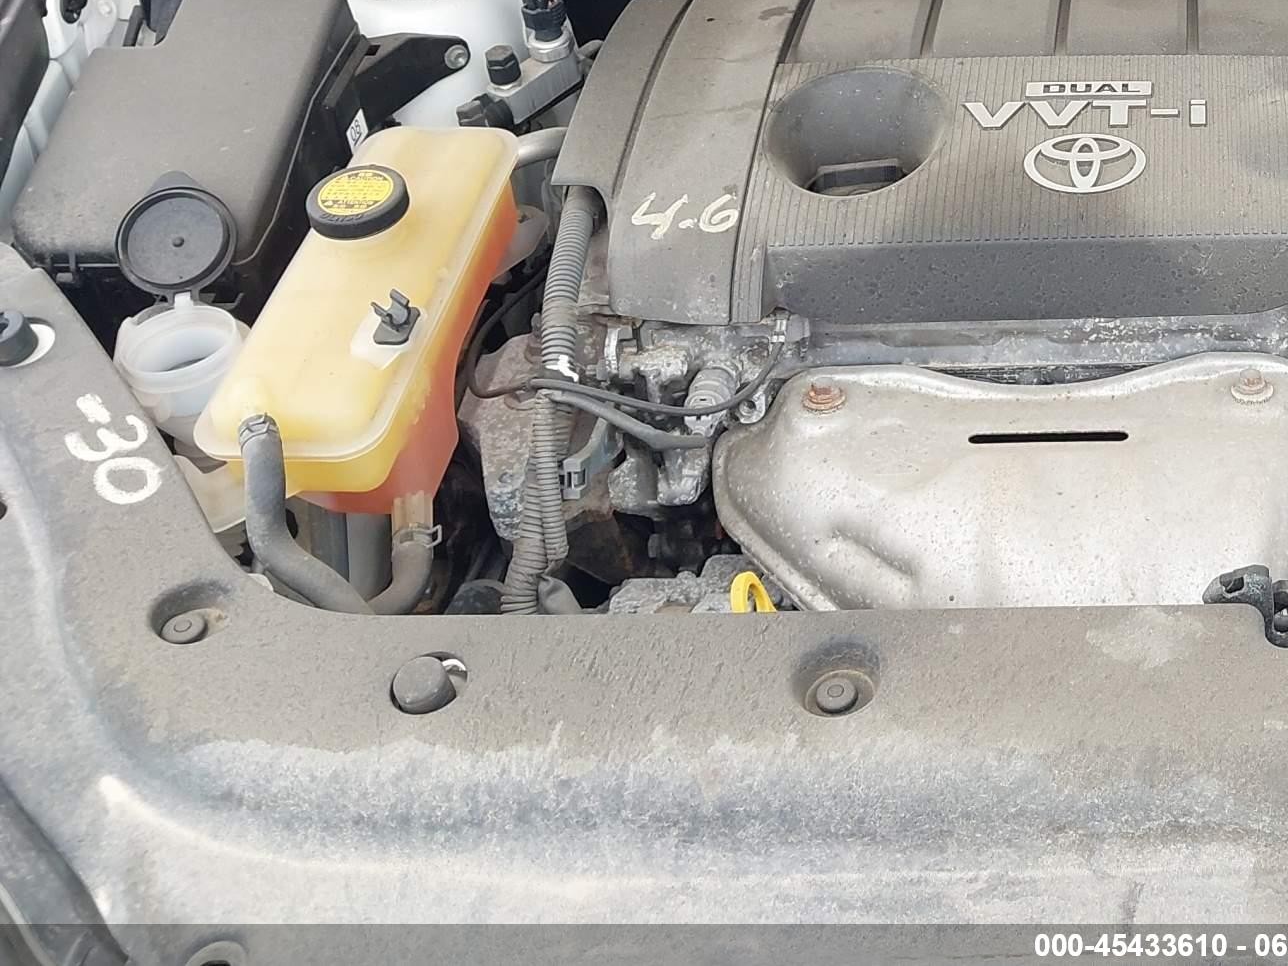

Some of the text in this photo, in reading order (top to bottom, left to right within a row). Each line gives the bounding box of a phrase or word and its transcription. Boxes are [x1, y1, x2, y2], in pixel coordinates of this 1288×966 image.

[1042, 83, 1141, 93] DUAL
[963, 99, 1208, 129] VVT-i
[631, 193, 739, 240] 4.6
